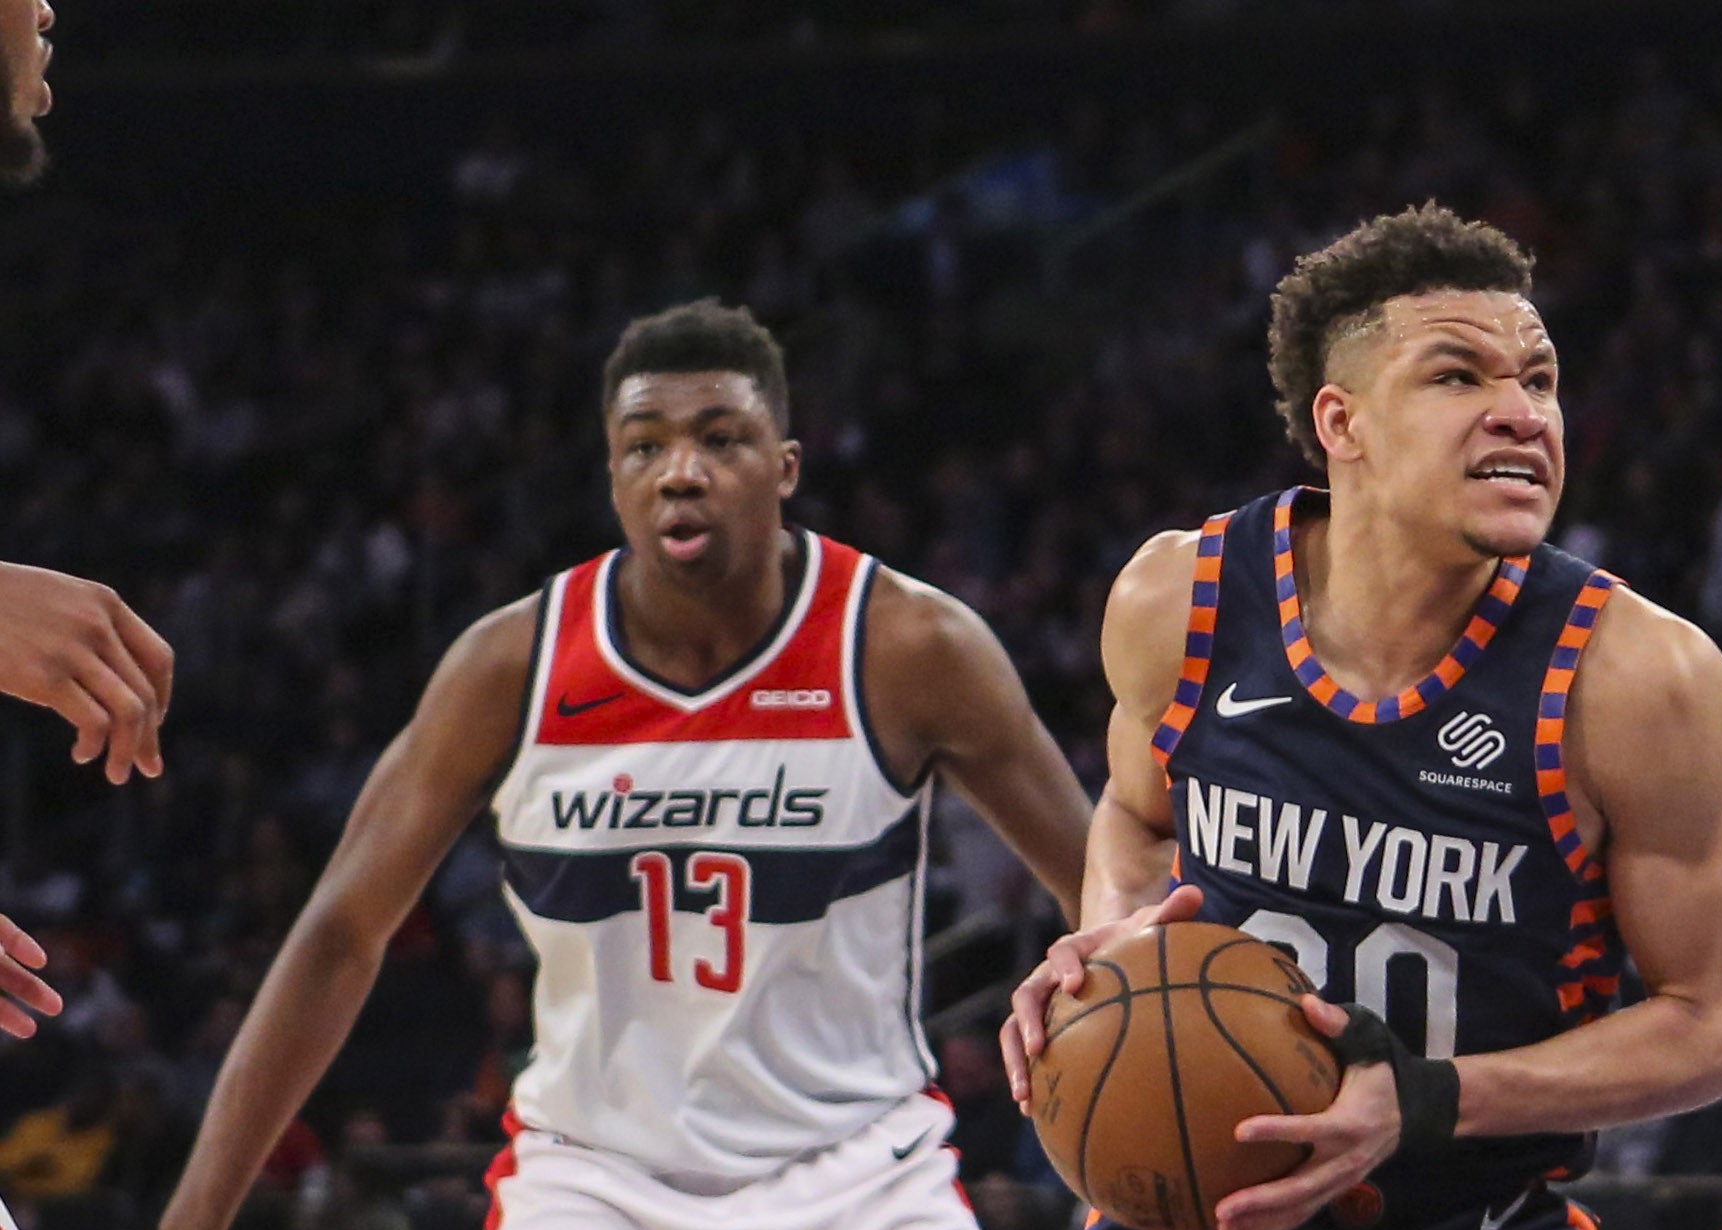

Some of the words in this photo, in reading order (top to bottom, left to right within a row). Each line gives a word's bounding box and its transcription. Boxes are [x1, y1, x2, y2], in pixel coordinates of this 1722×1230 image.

[749, 688, 832, 709] GEICO
[550, 763, 831, 831] wizards
[1418, 769, 1513, 795] SQUARESPACE
[1186, 776, 1328, 891] NEW
[1341, 814, 1529, 924] YORK
[630, 851, 752, 995] 13
